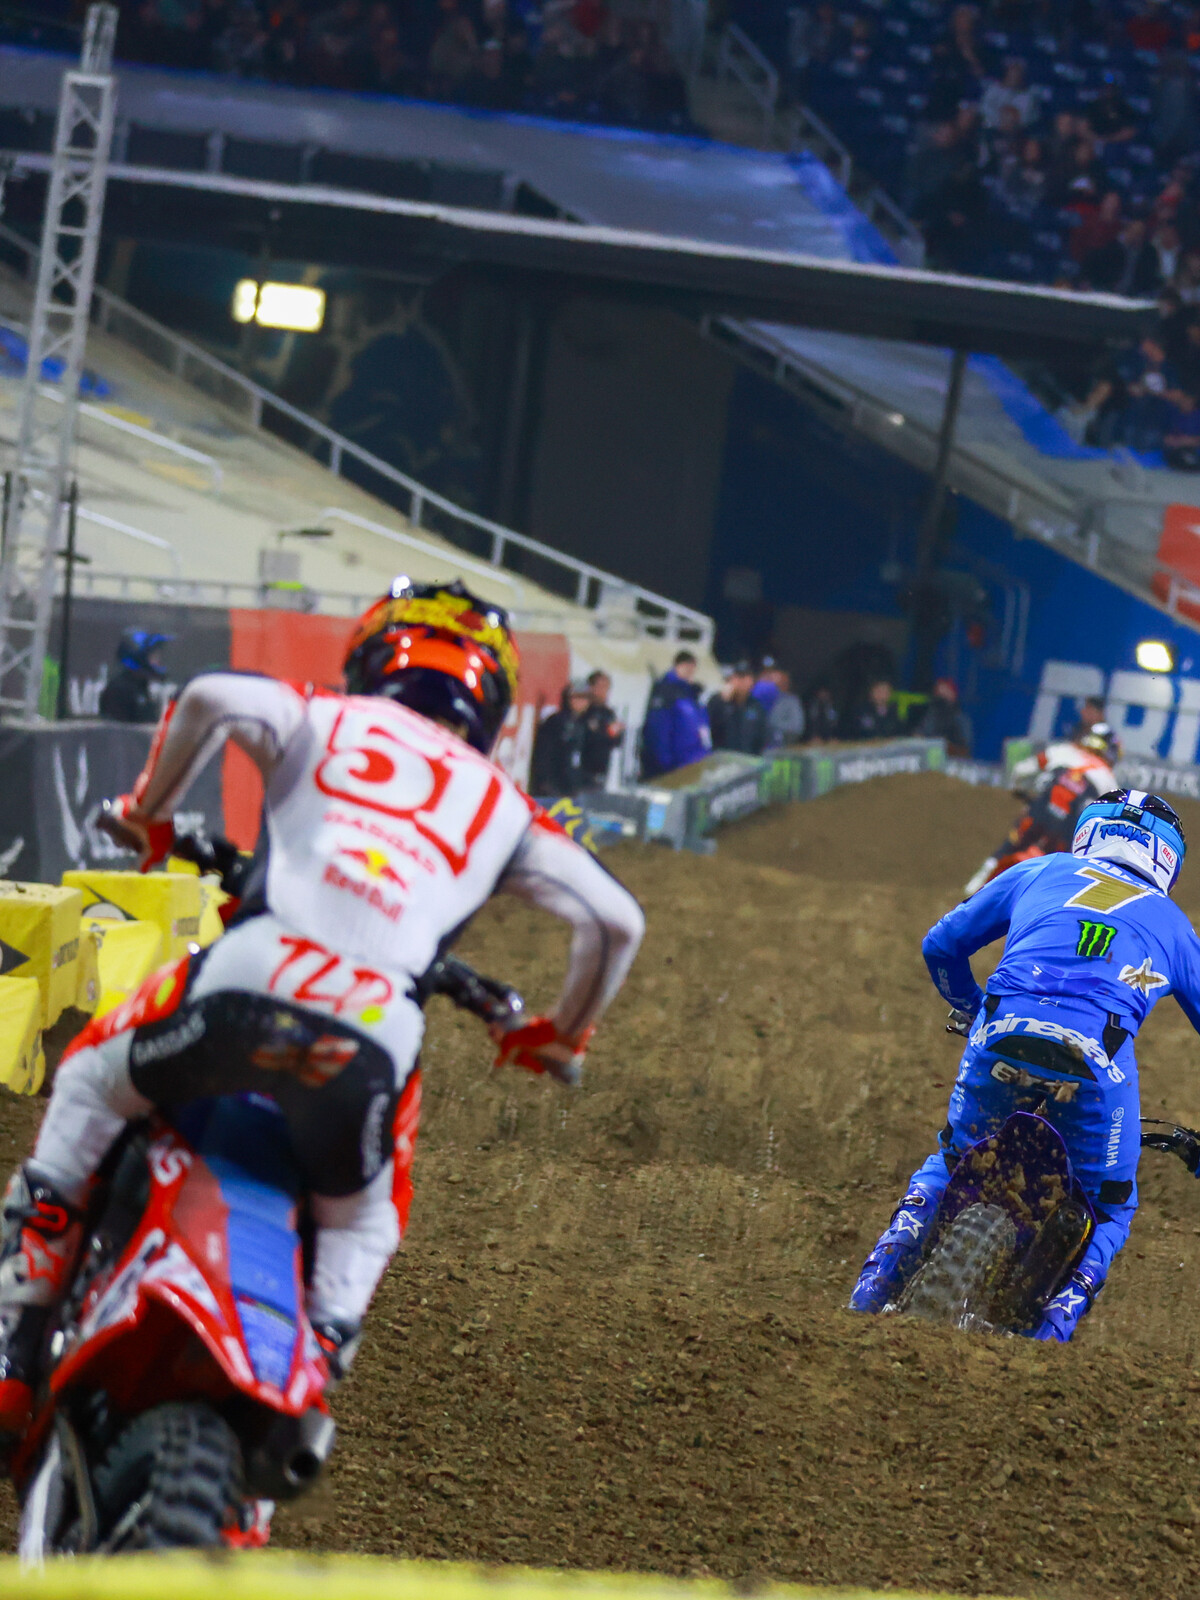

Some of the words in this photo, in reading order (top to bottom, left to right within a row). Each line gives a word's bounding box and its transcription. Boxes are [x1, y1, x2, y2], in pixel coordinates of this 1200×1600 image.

[313, 706, 503, 877] 51
[1075, 829, 1088, 844] BELL
[1099, 824, 1152, 849] TOMAC
[1162, 847, 1174, 865] BELL
[1105, 1120, 1123, 1168] YAMAHA
